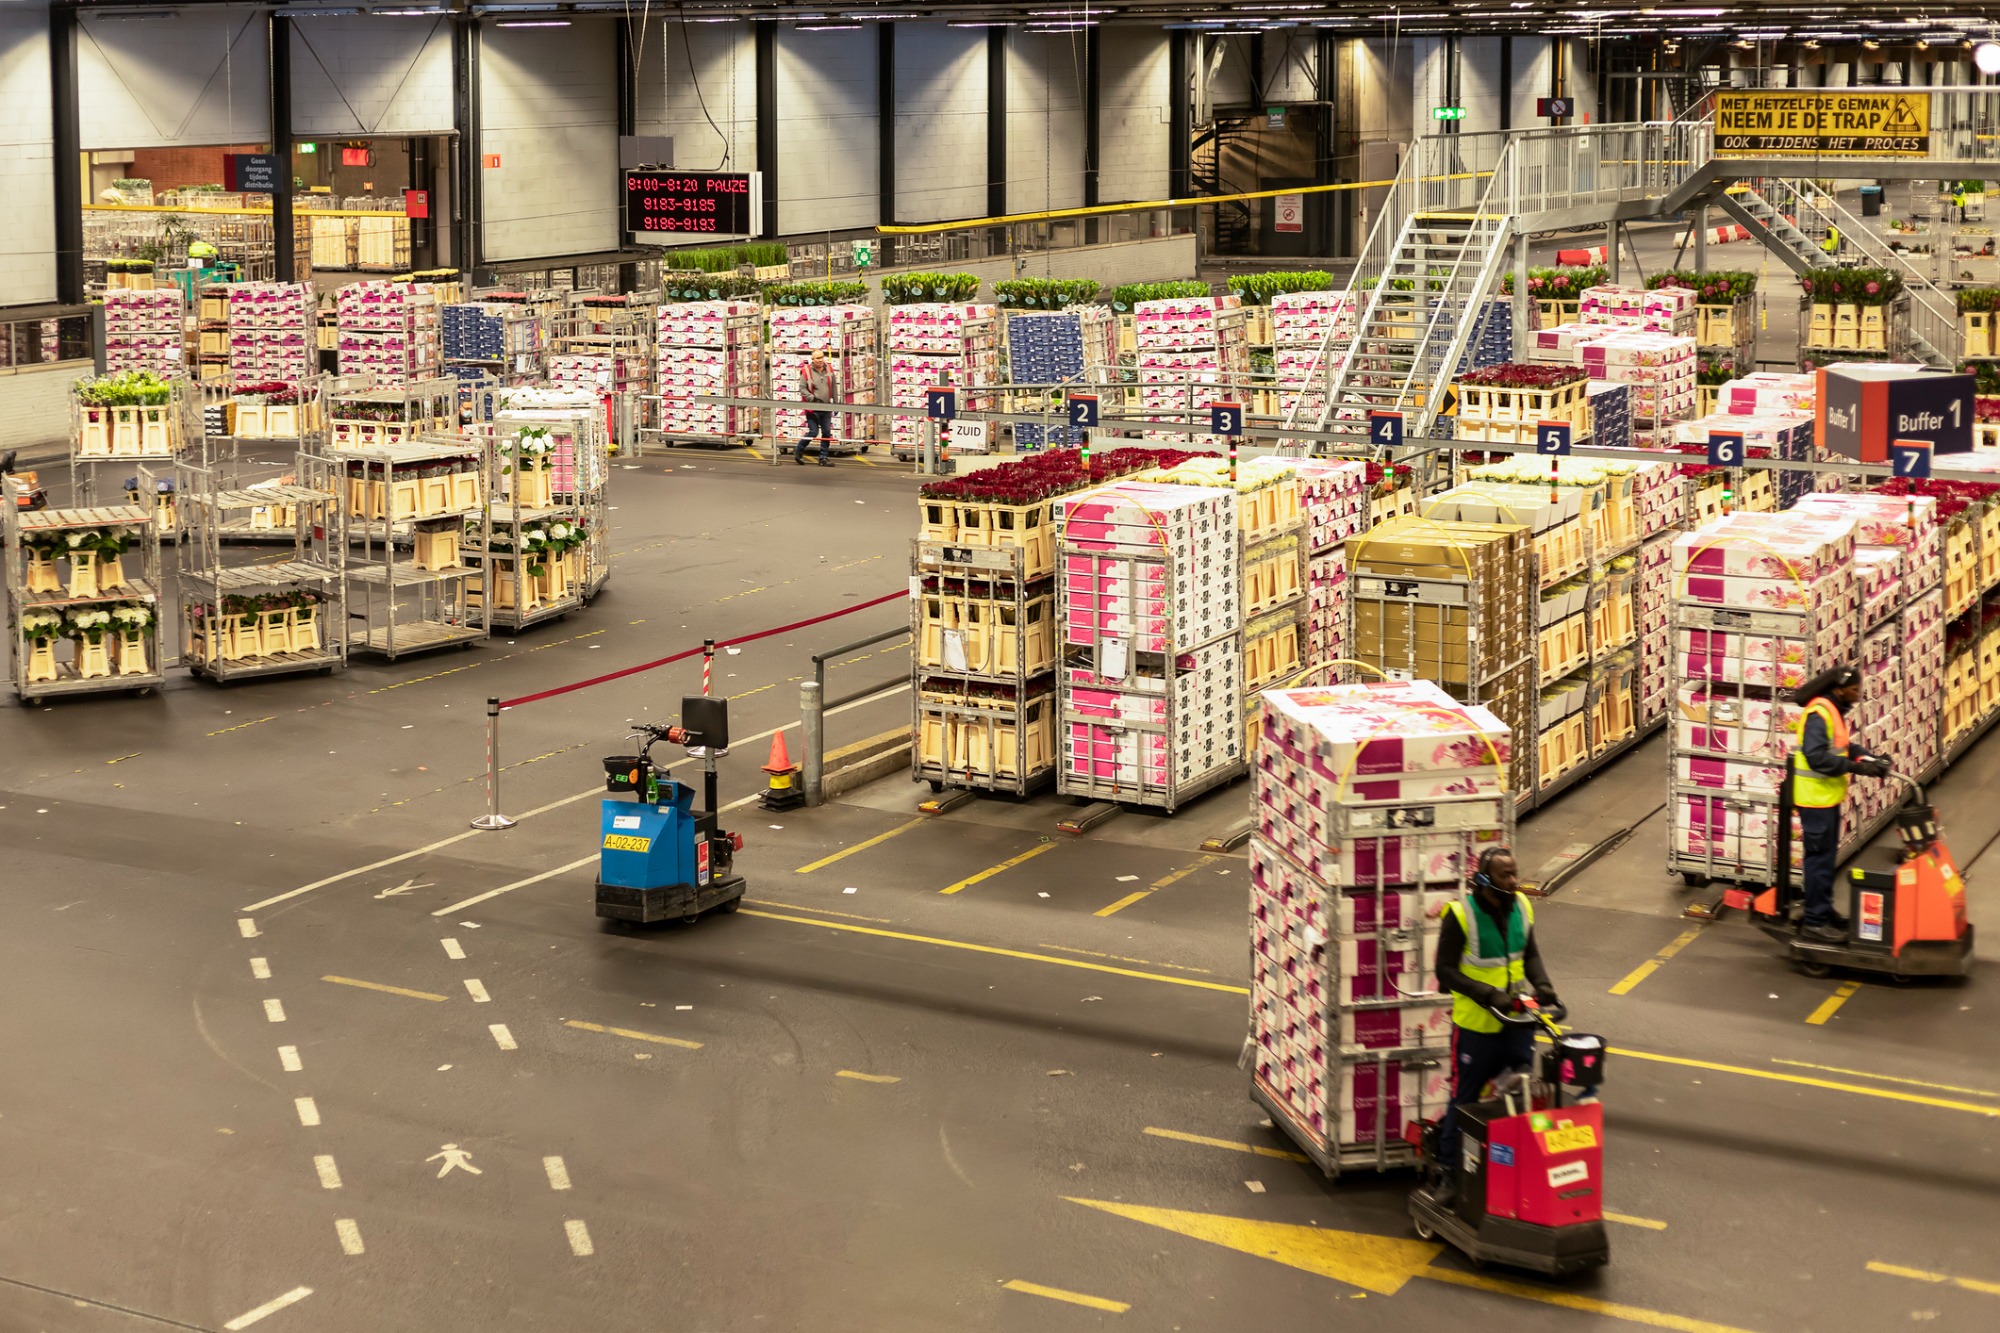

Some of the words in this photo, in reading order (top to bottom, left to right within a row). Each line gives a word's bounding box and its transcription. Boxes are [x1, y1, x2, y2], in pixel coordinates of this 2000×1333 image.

[1721, 98, 1749, 110] MET
[1754, 98, 1833, 110] HETZELFDE
[1838, 98, 1890, 111] GEMAK
[1721, 112, 1773, 128] NEEM
[1778, 112, 1797, 129] JE
[1803, 112, 1827, 129] DE
[1832, 112, 1881, 129] TRAP
[1724, 136, 1750, 148] OOK
[1759, 137, 1820, 149] TIJDENS
[1828, 137, 1857, 149] HET
[1864, 137, 1920, 150] PROCES
[245, 165, 272, 174] doorgang
[628, 178, 698, 191] 8:00-8:20
[706, 180, 748, 193] PAUZE
[643, 198, 716, 211] 9183-9185
[936, 396, 945, 414] 1
[1077, 404, 1089, 422] 2
[1219, 411, 1232, 431] 3
[1829, 407, 1849, 429] Buffer
[1850, 403, 1857, 432] 1
[1899, 411, 1944, 432] Buffer
[1949, 399, 1962, 428] 1
[957, 425, 981, 437] ZUID
[1379, 421, 1393, 440] 4
[1546, 431, 1561, 451] 5
[1717, 440, 1734, 462] 6
[1903, 451, 1920, 473] 7
[604, 835, 650, 851] A-02-237
